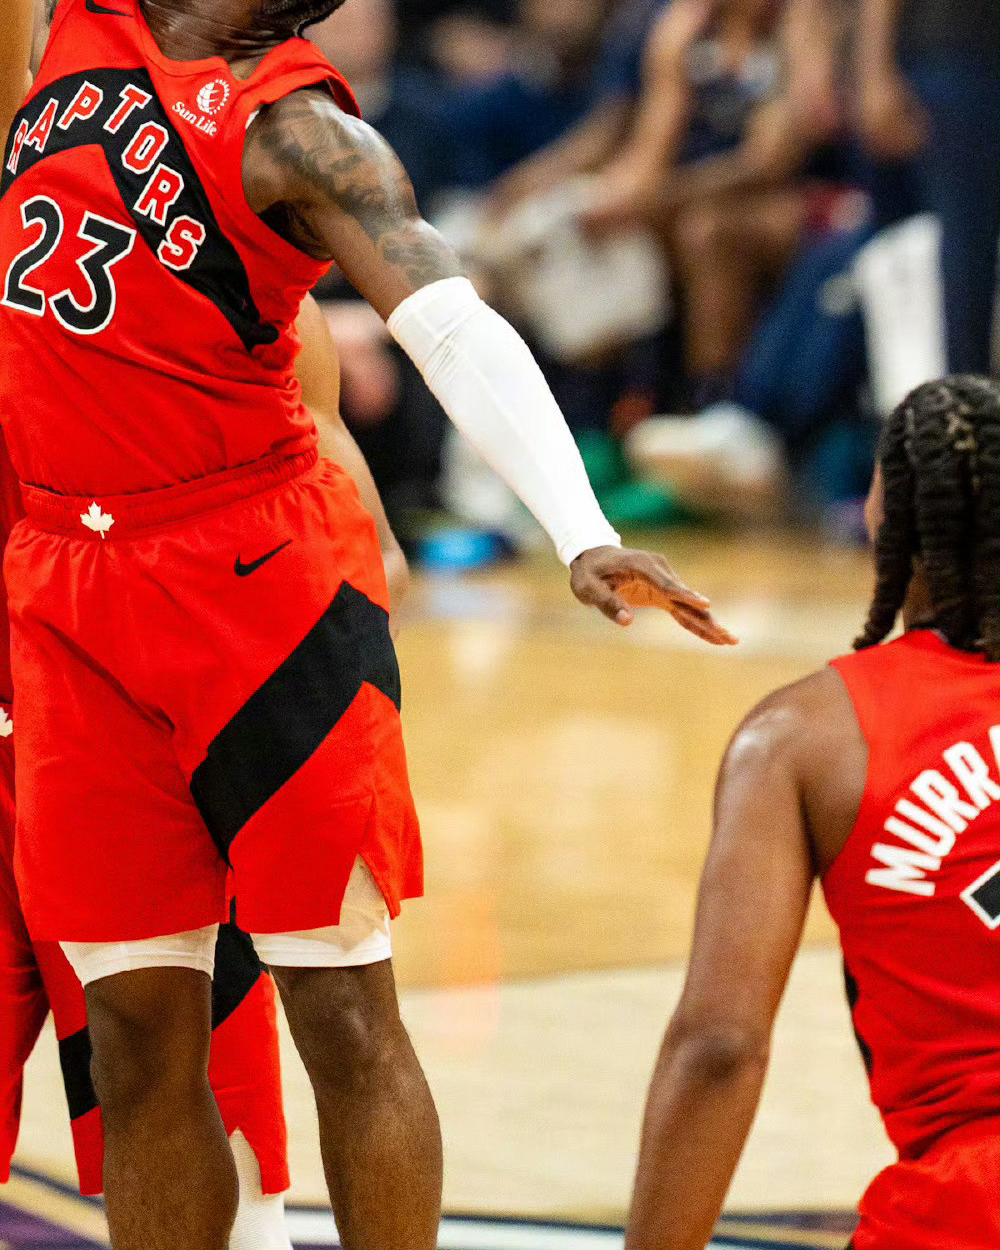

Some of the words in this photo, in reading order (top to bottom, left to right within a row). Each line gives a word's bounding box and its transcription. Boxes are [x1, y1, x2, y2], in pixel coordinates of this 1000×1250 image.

[6, 80, 206, 271] RAPTORS
[171, 100, 197, 125] Sun
[195, 115, 217, 136] Life
[0, 194, 137, 335] 23
